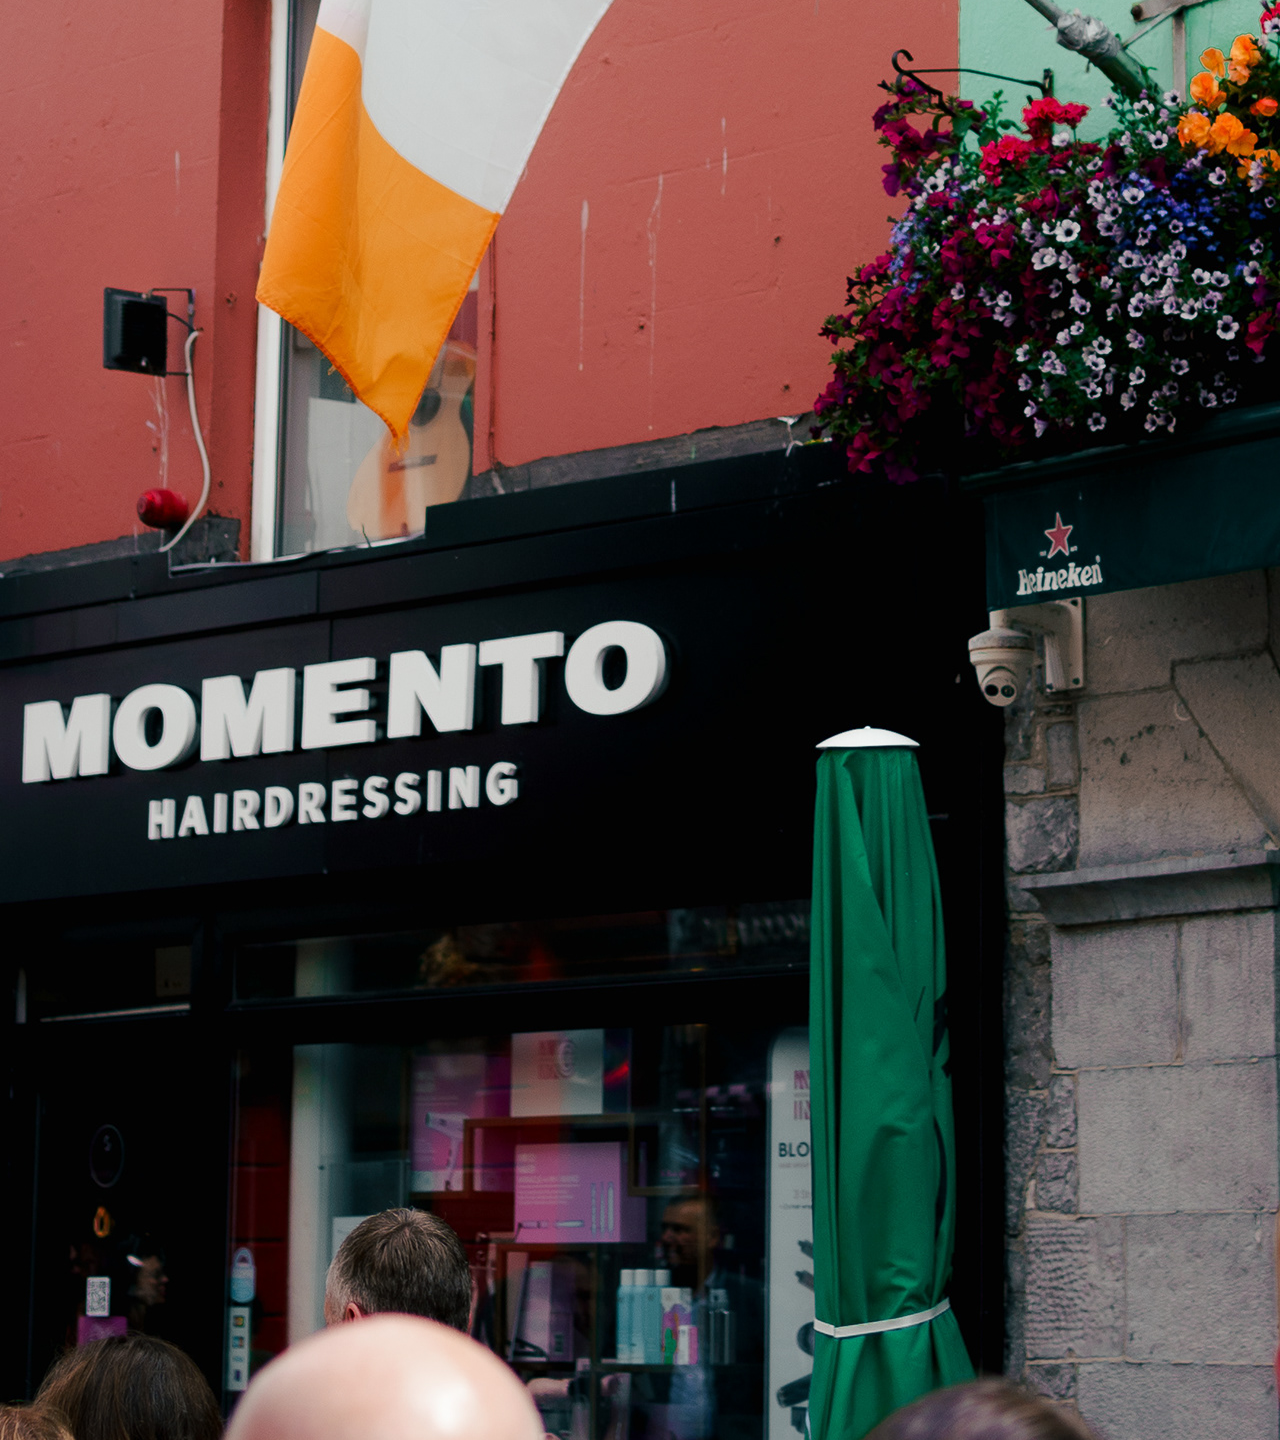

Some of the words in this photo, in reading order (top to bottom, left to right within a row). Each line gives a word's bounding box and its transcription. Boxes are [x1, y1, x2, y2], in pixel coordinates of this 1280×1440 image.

[1016, 562, 1104, 596] Heineken
[22, 620, 669, 785] MOMENTO
[148, 762, 520, 841] HAIRDRESSING
